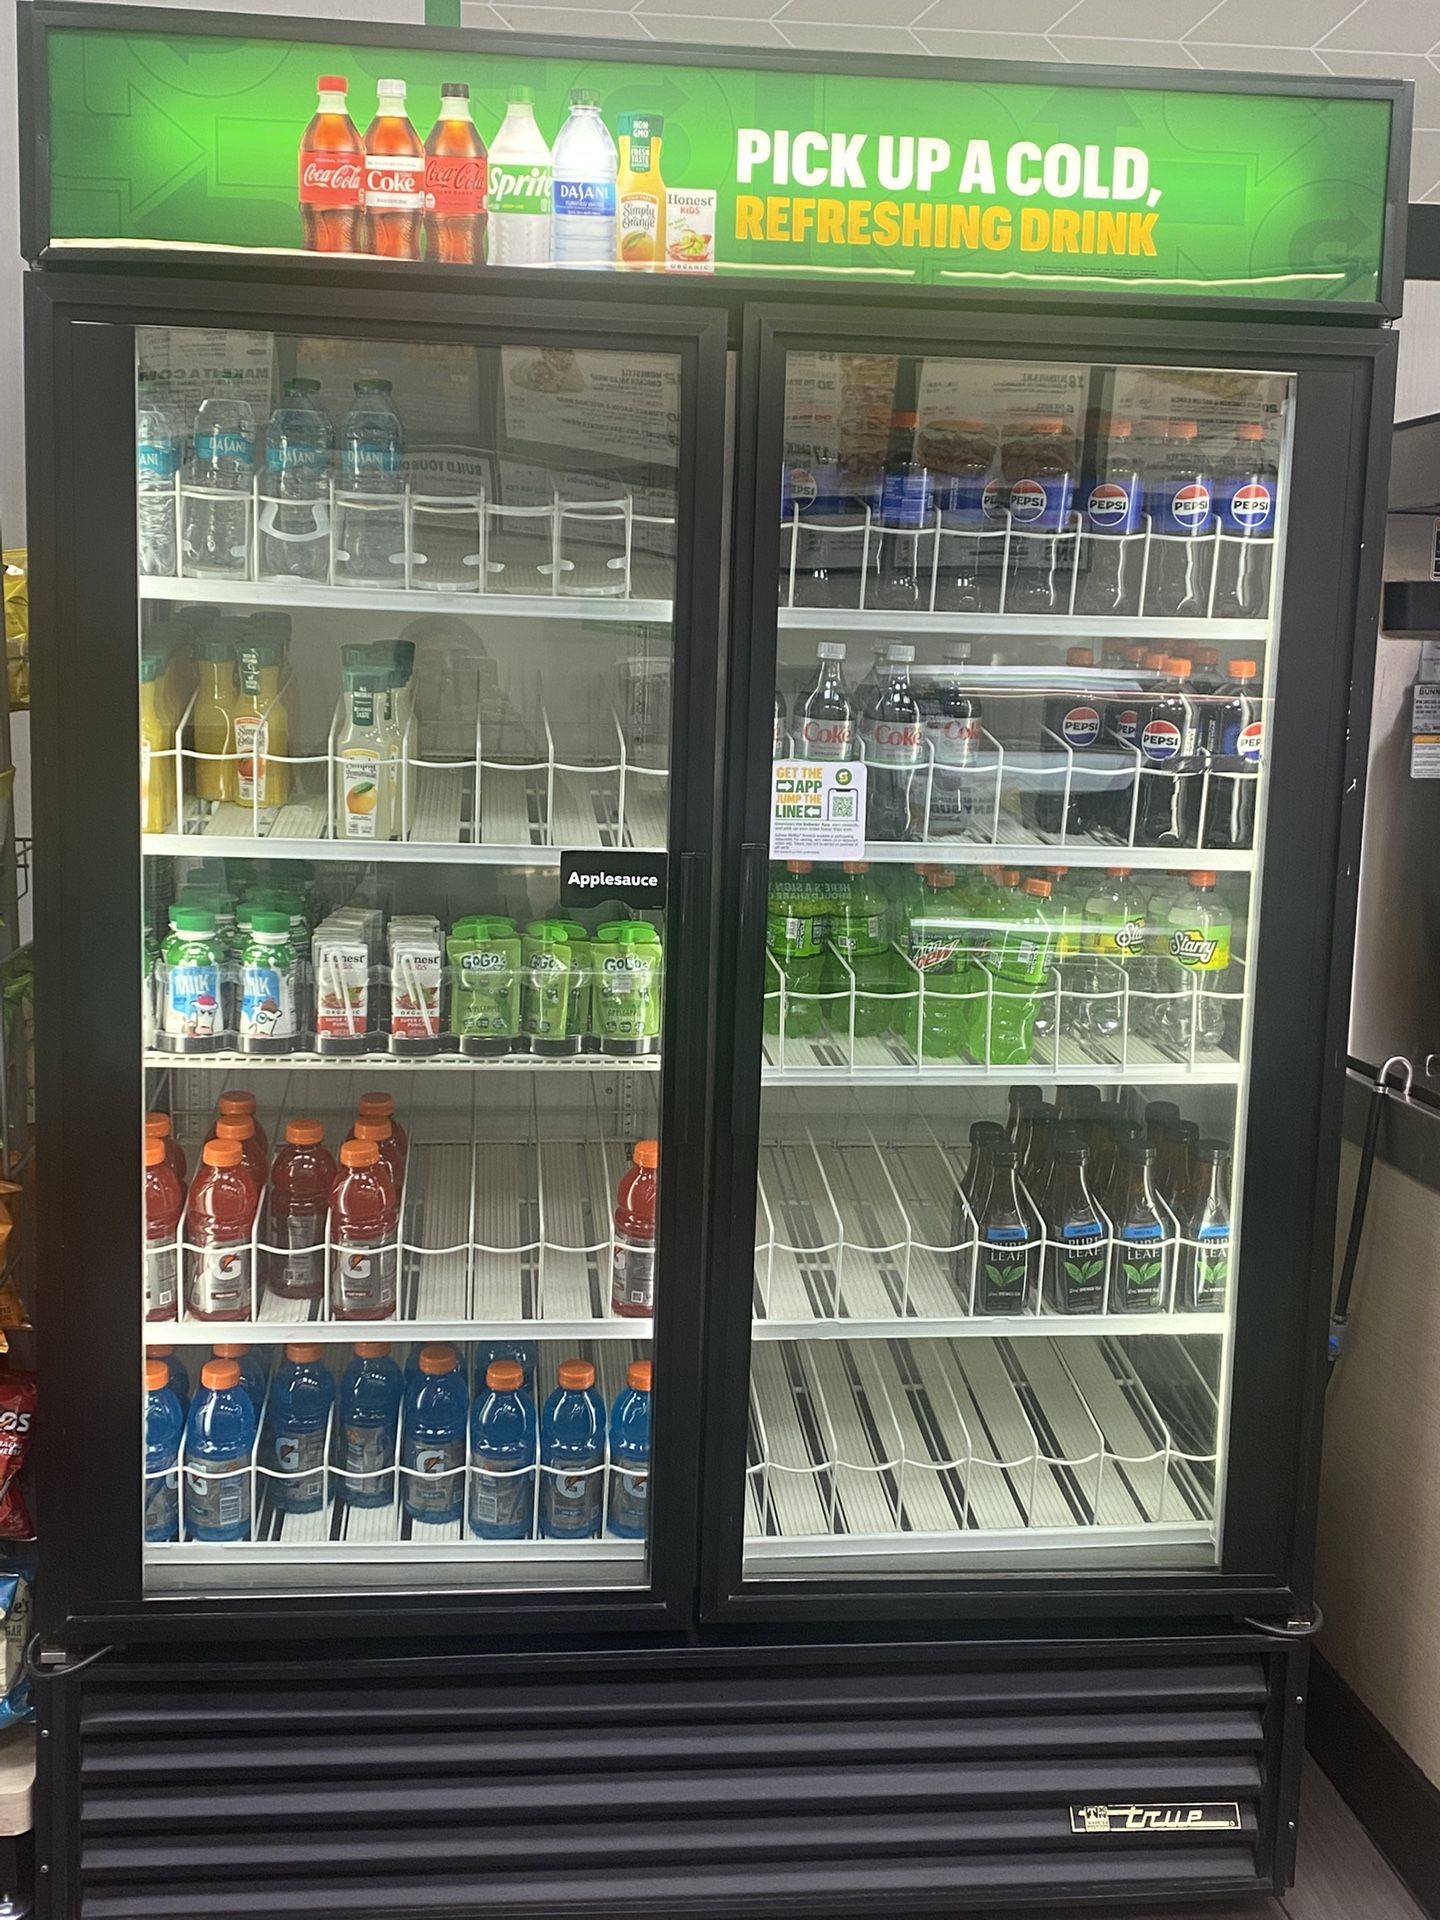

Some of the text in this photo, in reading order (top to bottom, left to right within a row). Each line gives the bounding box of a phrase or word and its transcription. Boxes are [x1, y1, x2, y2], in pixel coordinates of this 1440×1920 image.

[633, 120, 649, 129] NON
[633, 129, 649, 138] GMO
[736, 127, 1162, 208] PICK UP A COLD,
[367, 170, 416, 192] Coke
[561, 183, 608, 201] DASANI
[668, 194, 714, 206] Honest
[623, 203, 655, 219] Simply
[622, 216, 656, 230] Orange
[735, 194, 1160, 257] REFRESHING DRINK
[670, 263, 709, 271] ORGANIC
[209, 436, 247, 453] DASANI
[279, 448, 315, 465] DASANI
[792, 484, 815, 495] EPSI
[1010, 496, 1044, 507] PEPSI
[1089, 500, 1127, 511] PEPSI
[1174, 501, 1208, 511] PEPSI
[1234, 501, 1268, 511] PEPSI
[803, 721, 850, 743] Coke
[944, 720, 980, 740] Cok
[1065, 721, 1098, 731] PEPSI
[1118, 724, 1137, 734] PEP
[875, 725, 923, 746] Coke
[1143, 734, 1178, 746] PEPSI
[1241, 738, 1261, 747] PEP
[776, 767, 823, 779] GET THE
[795, 780, 822, 793] APP
[776, 794, 822, 804] JUMP THE
[775, 805, 803, 818] LINE
[567, 871, 658, 888] Applesauce
[1171, 931, 1217, 962] Starry
[175, 975, 210, 996] MILK
[991, 1252, 1025, 1261] LEAF
[1069, 1247, 1100, 1258] LEAF
[1128, 1247, 1160, 1260] LEAF
[1203, 1247, 1227, 1258] LEA
[275, 1437, 299, 1470] G
[417, 1450, 447, 1481] G
[556, 1467, 586, 1499] G
[1126, 1806, 1203, 1828] true
